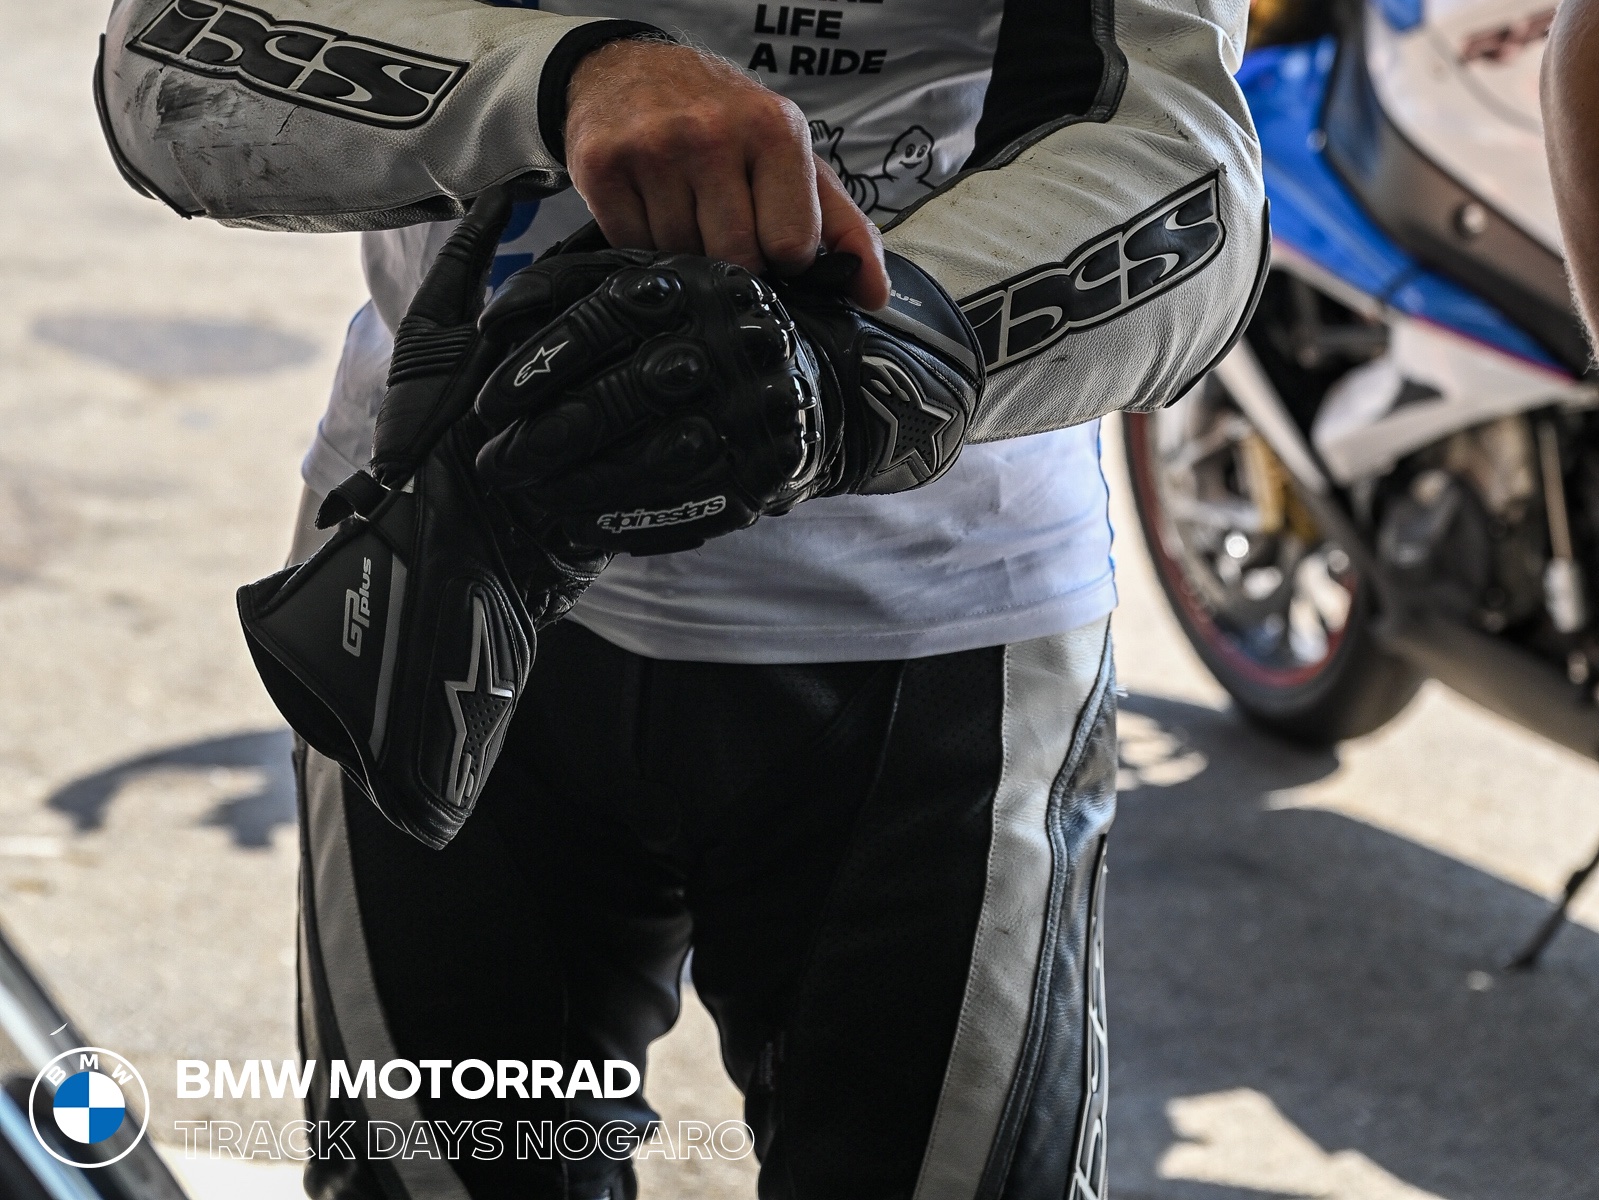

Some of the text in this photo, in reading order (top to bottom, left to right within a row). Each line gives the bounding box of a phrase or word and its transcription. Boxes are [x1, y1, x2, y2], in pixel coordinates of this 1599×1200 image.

[754, 3, 843, 40] LIFE
[748, 42, 888, 76] A RIDE
[596, 495, 726, 533] alpinestars
